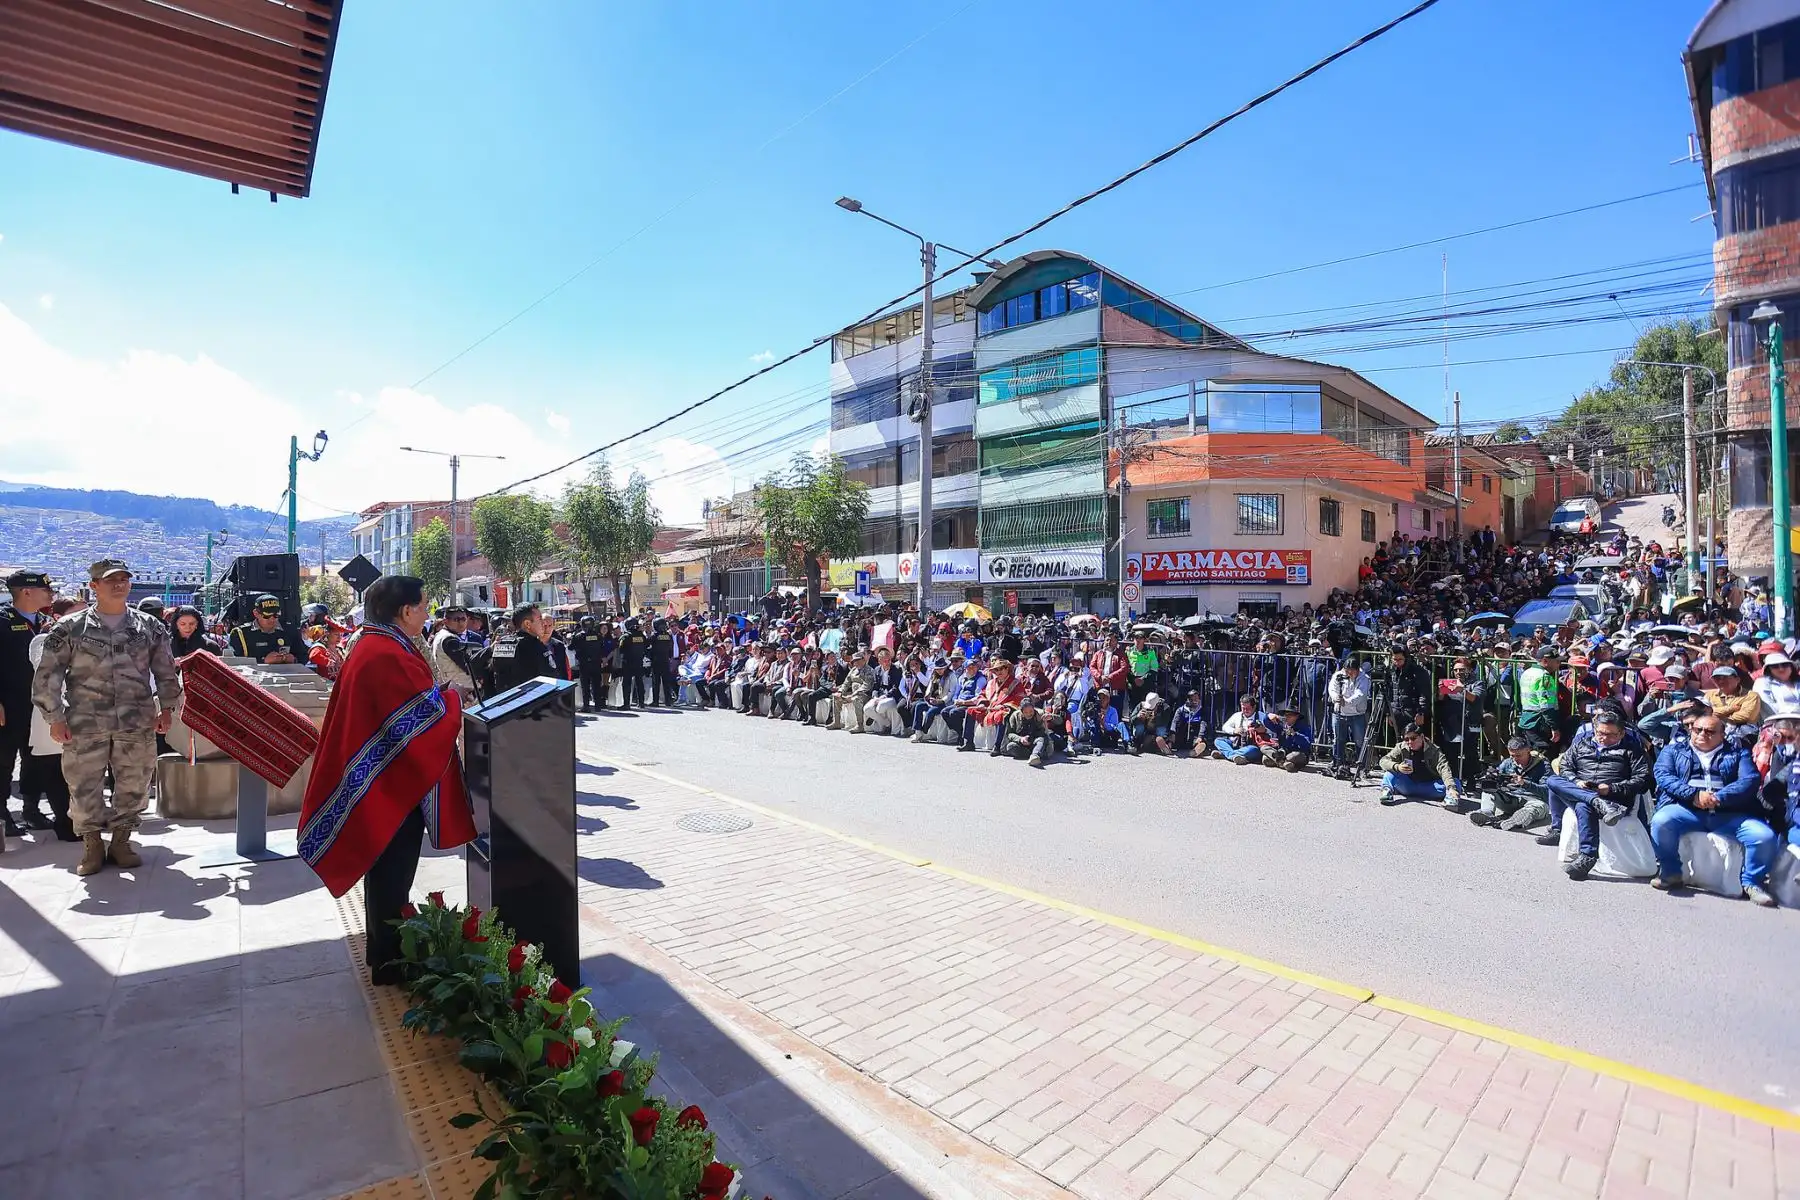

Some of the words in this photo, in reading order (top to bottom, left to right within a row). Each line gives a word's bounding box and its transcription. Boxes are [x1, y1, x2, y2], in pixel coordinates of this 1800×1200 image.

[1009, 561, 1068, 579] REGIONAL
[1069, 567, 1081, 576] del
[1083, 565, 1096, 576] Sur
[1144, 551, 1285, 571] FARMACIA
[857, 572, 870, 594] H
[1168, 569, 1208, 578] PATRÓN
[1211, 570, 1267, 578] SANTIAGO
